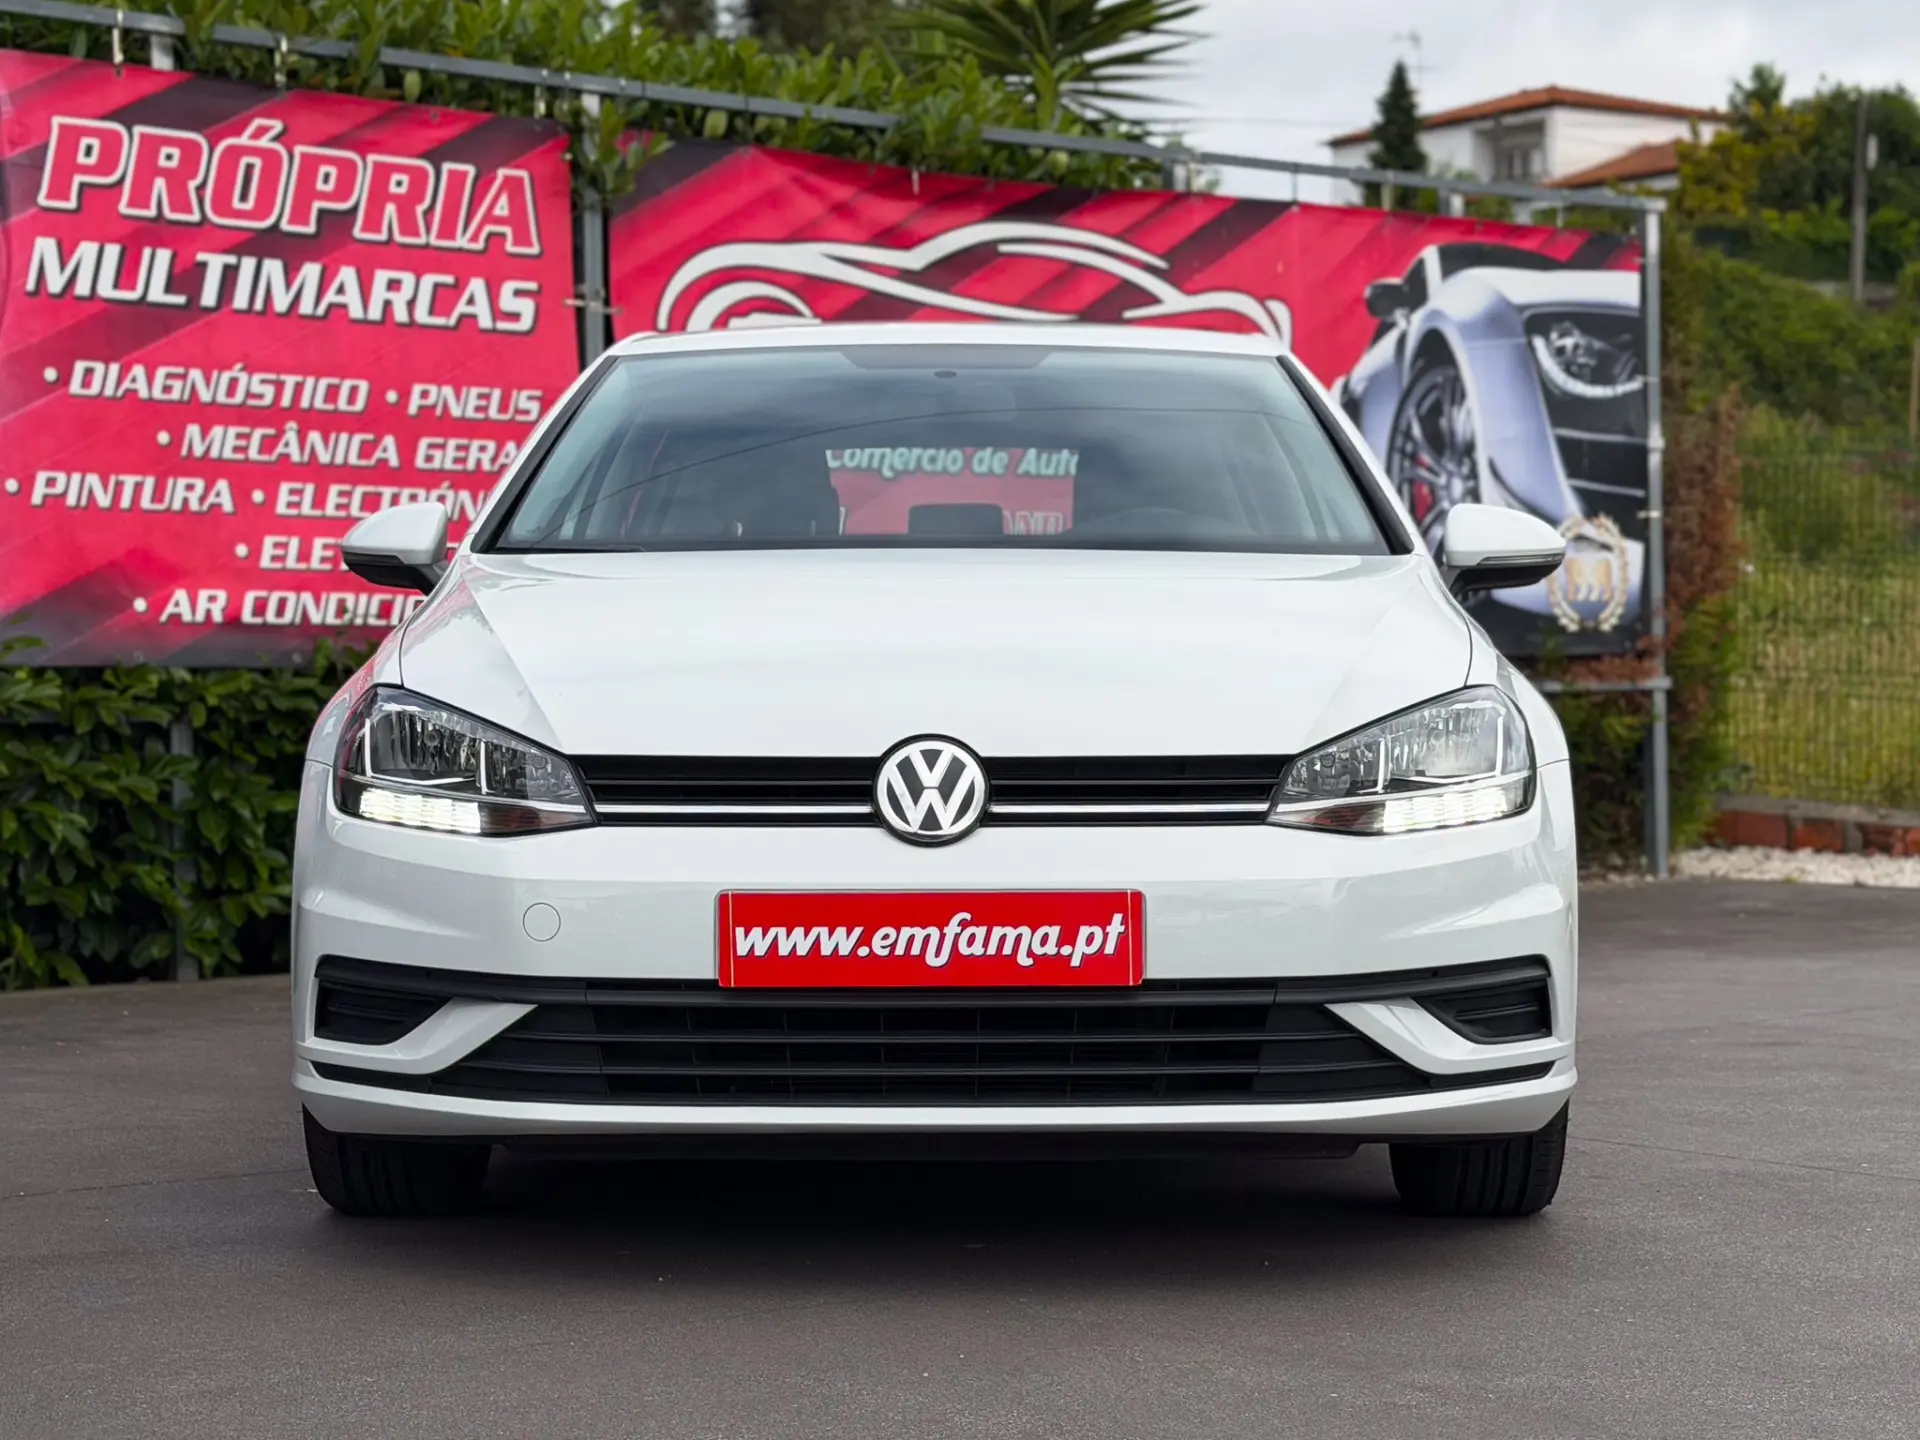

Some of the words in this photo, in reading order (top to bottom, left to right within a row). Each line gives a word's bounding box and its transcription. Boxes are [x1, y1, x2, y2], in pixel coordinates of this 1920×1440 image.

[37, 116, 542, 256] PRÓPRIA
[25, 236, 539, 334] MULTIMARCAS
[69, 359, 369, 414] DIAGNÓSTICO
[407, 382, 543, 422] PNEUS
[180, 421, 400, 468] MECÂNICA
[972, 447, 1009, 475] de
[30, 470, 234, 514] PINTURA
[160, 588, 228, 624] AR
[735, 911, 1125, 967] www.emfama.pt
